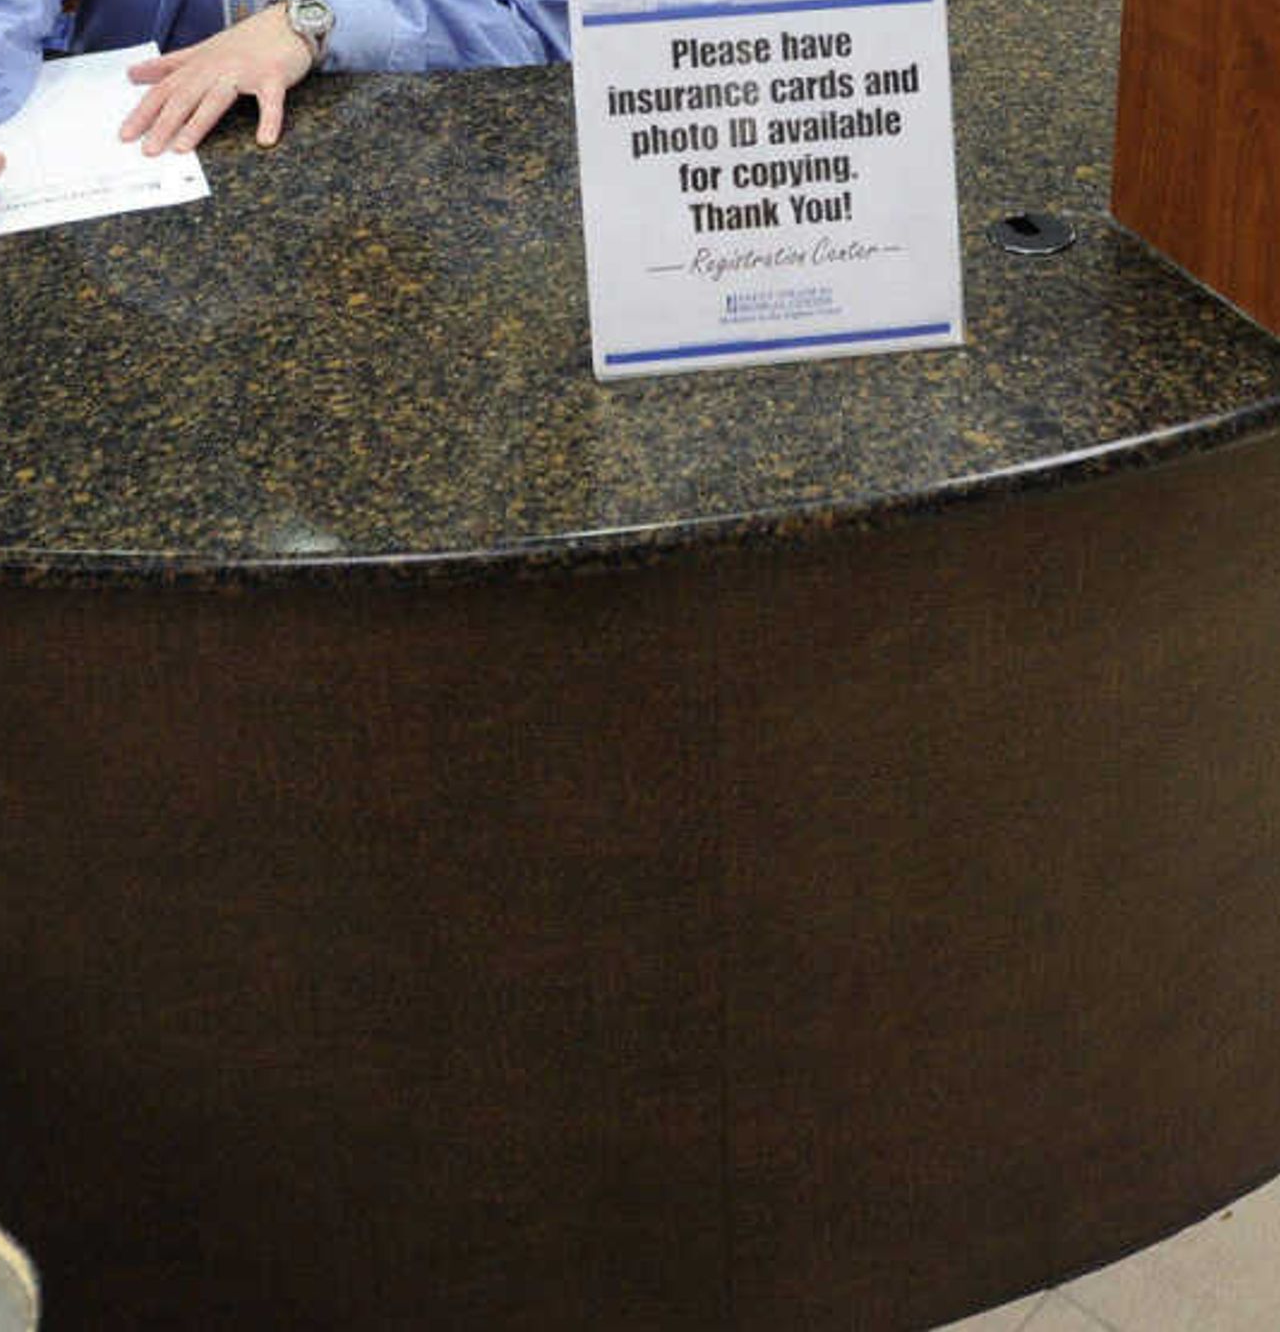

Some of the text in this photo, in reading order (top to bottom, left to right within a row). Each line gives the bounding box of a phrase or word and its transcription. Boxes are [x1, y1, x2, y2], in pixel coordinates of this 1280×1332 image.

[671, 31, 853, 69] Please have
[608, 63, 920, 116] insurance cards and
[631, 107, 902, 160] photo ID available
[679, 153, 860, 194] for copying.
[688, 191, 853, 234] Thank You!
[692, 235, 877, 282] Registration Center
